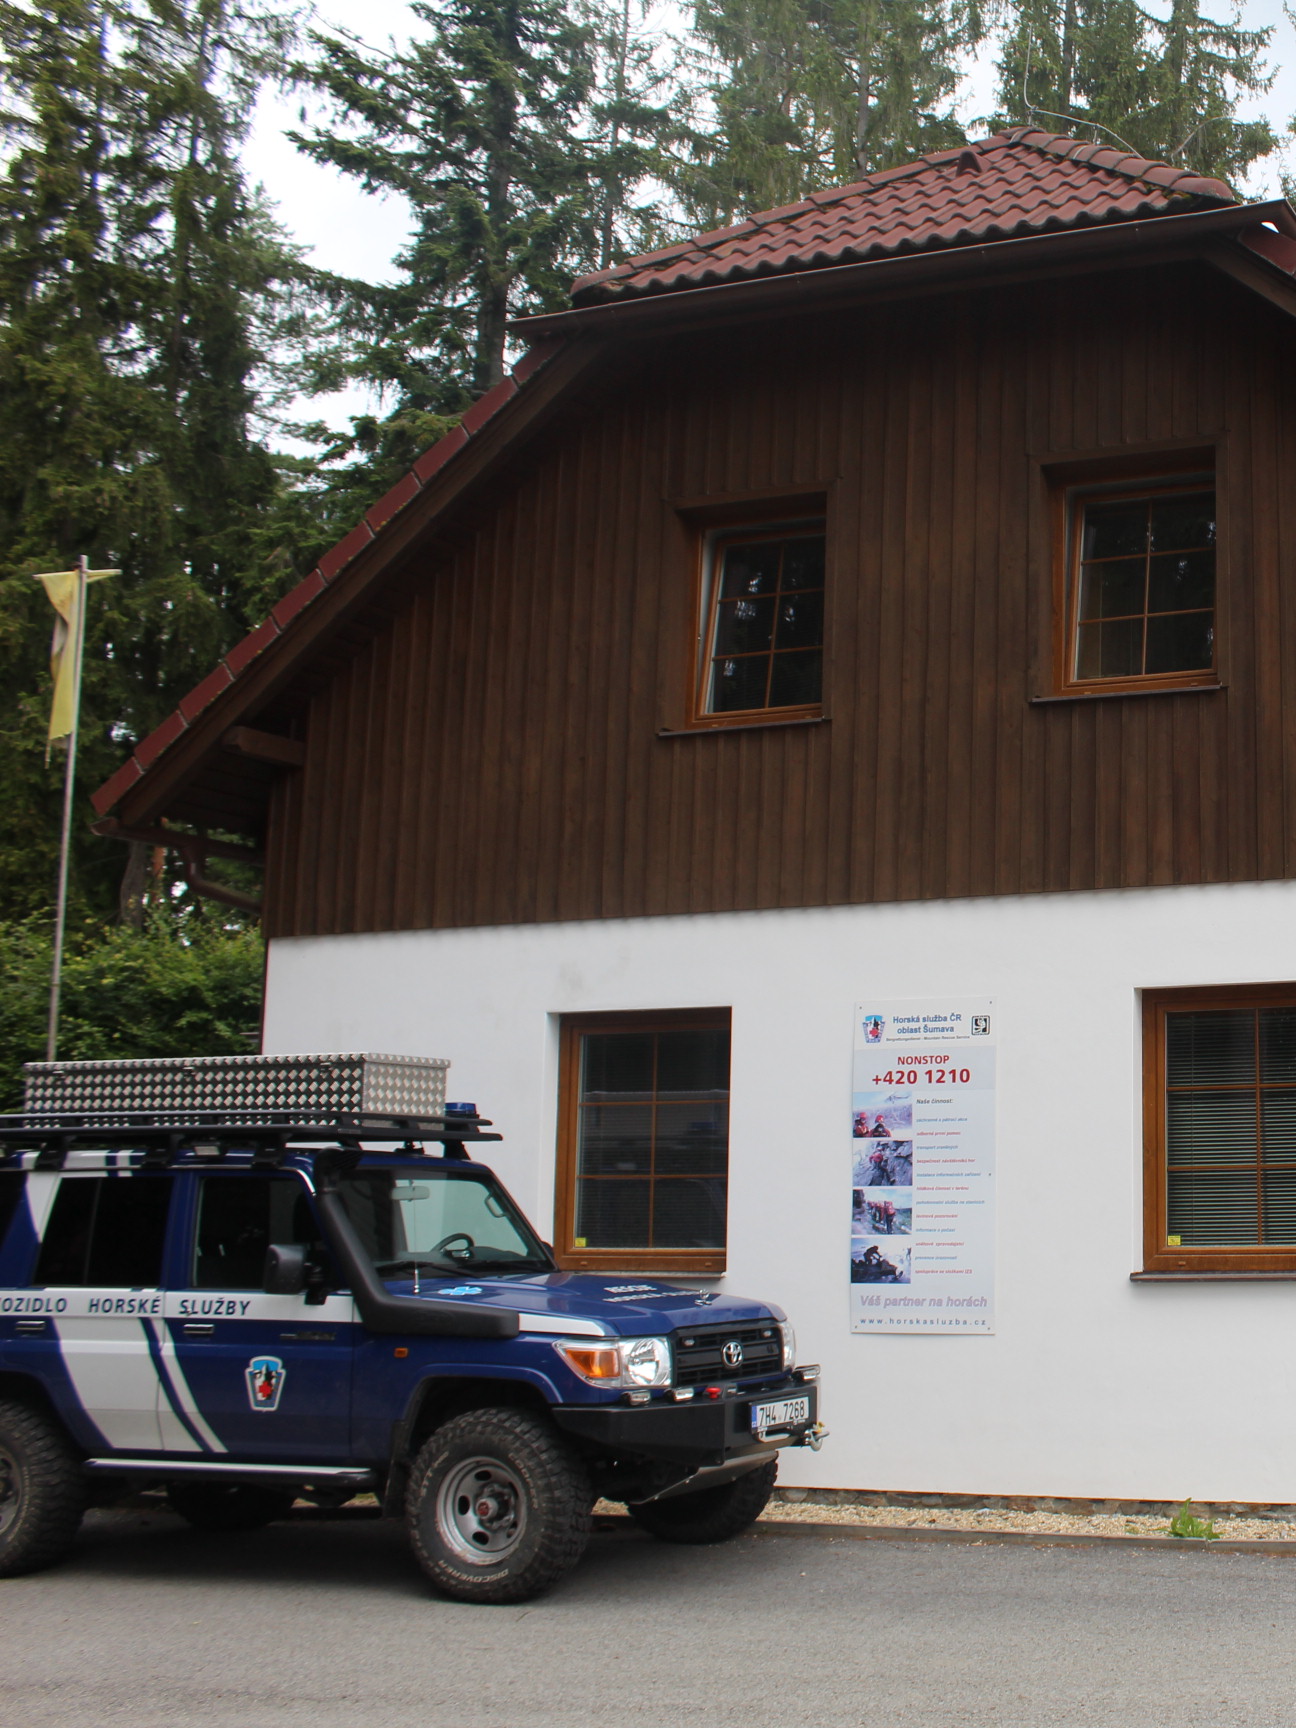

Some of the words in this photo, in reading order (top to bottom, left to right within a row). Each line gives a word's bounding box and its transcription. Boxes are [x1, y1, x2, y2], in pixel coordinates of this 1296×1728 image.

[893, 1015, 920, 1024] Horská
[922, 1014, 948, 1023] služba
[949, 1012, 962, 1022] ČR
[897, 1026, 922, 1034] oblast
[923, 1024, 955, 1034] Šumava
[897, 1055, 950, 1066] NONSTOP
[872, 1070, 918, 1085] +420
[924, 1068, 971, 1084] 1210
[0, 1297, 68, 1313] OZIDLO
[88, 1296, 161, 1315] HORSKÉ
[178, 1297, 252, 1316] SLUŽBY
[860, 1295, 881, 1307] Váš
[883, 1296, 927, 1309] partner
[928, 1298, 944, 1307] na
[945, 1295, 988, 1307] horách
[860, 1318, 987, 1326] www.horskasluzba.cz
[759, 1406, 777, 1427] 7H4
[783, 1400, 805, 1422] 7268
